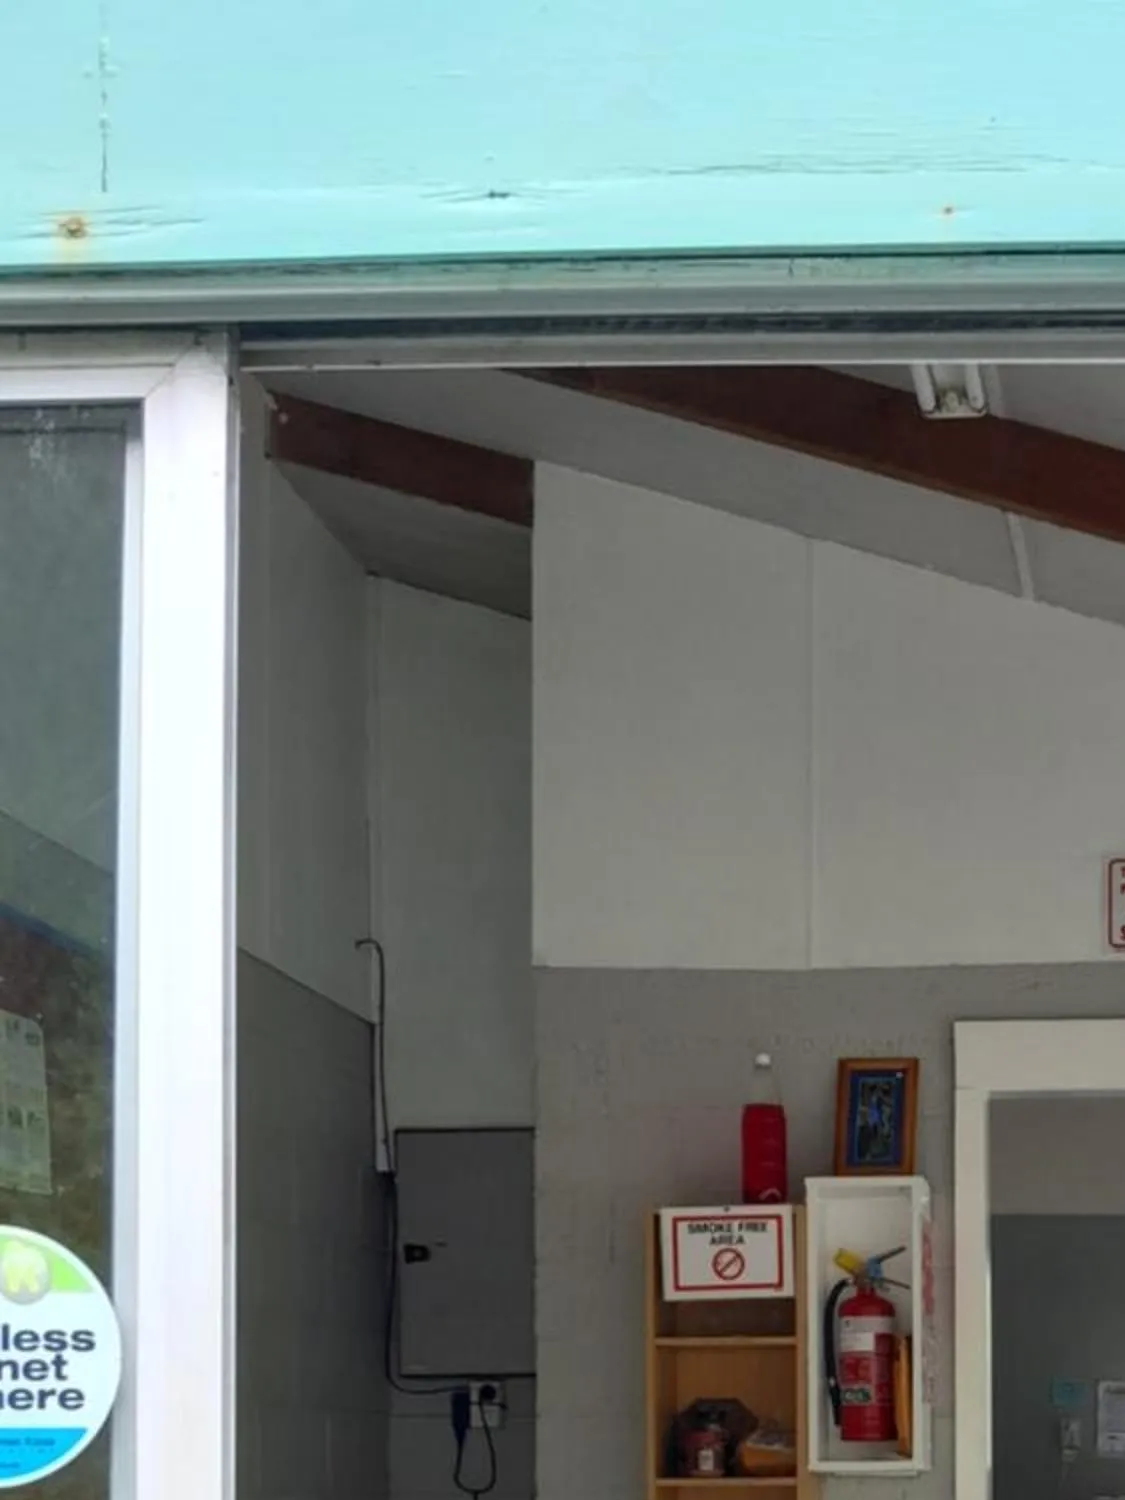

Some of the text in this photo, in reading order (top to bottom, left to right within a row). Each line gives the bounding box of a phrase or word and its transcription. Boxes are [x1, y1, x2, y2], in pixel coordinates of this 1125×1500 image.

[687, 1222, 767, 1234] SMOKE FREE
[709, 1235, 745, 1245] AREA
[0, 1388, 86, 1411] ere
